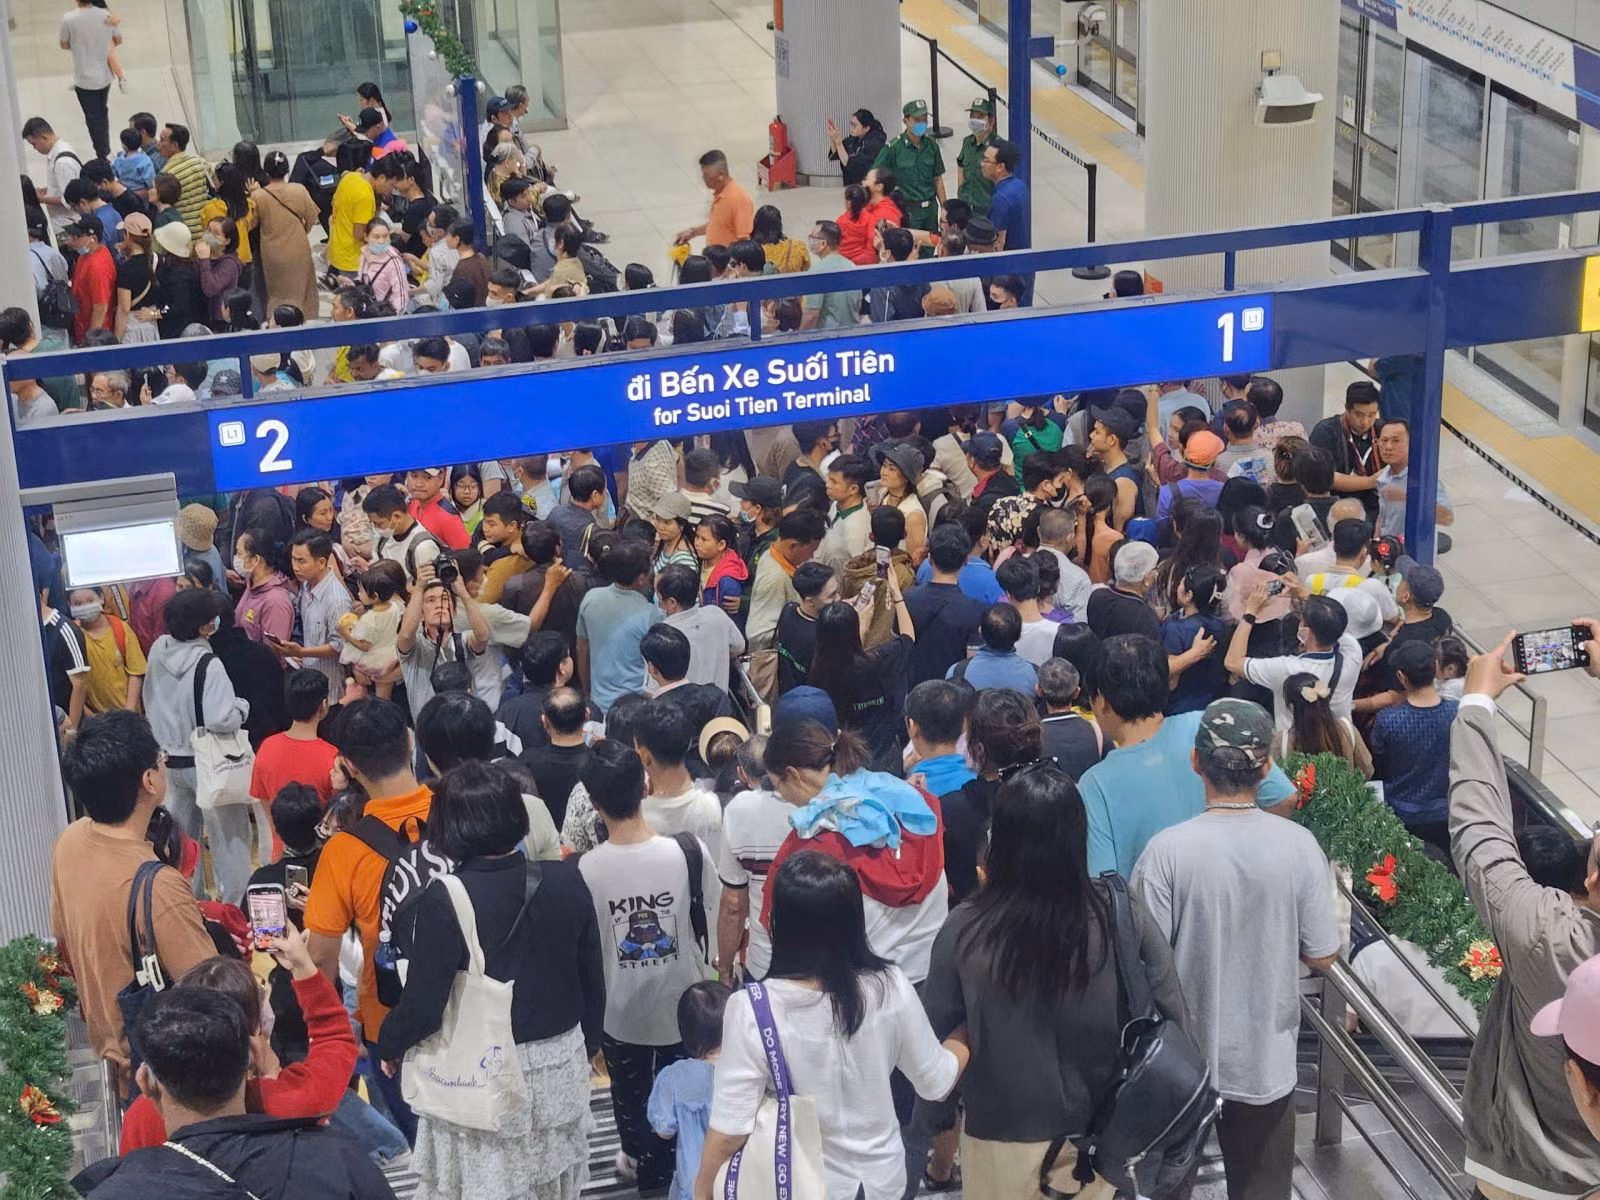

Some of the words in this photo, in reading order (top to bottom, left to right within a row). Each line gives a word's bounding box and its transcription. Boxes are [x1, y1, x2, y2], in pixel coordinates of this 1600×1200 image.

[1217, 312, 1234, 362] 1
[626, 373, 651, 401] đi
[660, 364, 715, 398] Bến
[722, 363, 760, 391] Xe
[767, 351, 829, 385] Suối
[835, 349, 895, 377] Tiên
[653, 407, 682, 426] for
[686, 400, 730, 421] Suoi
[735, 396, 778, 416] Tien
[783, 383, 871, 411] Terminal
[256, 419, 293, 473] 2
[608, 891, 674, 916] KING
[763, 1027, 775, 1048] DO
[780, 1096, 788, 1122] TRY
[777, 1125, 787, 1158] NEW
[777, 1163, 787, 1184] GO
